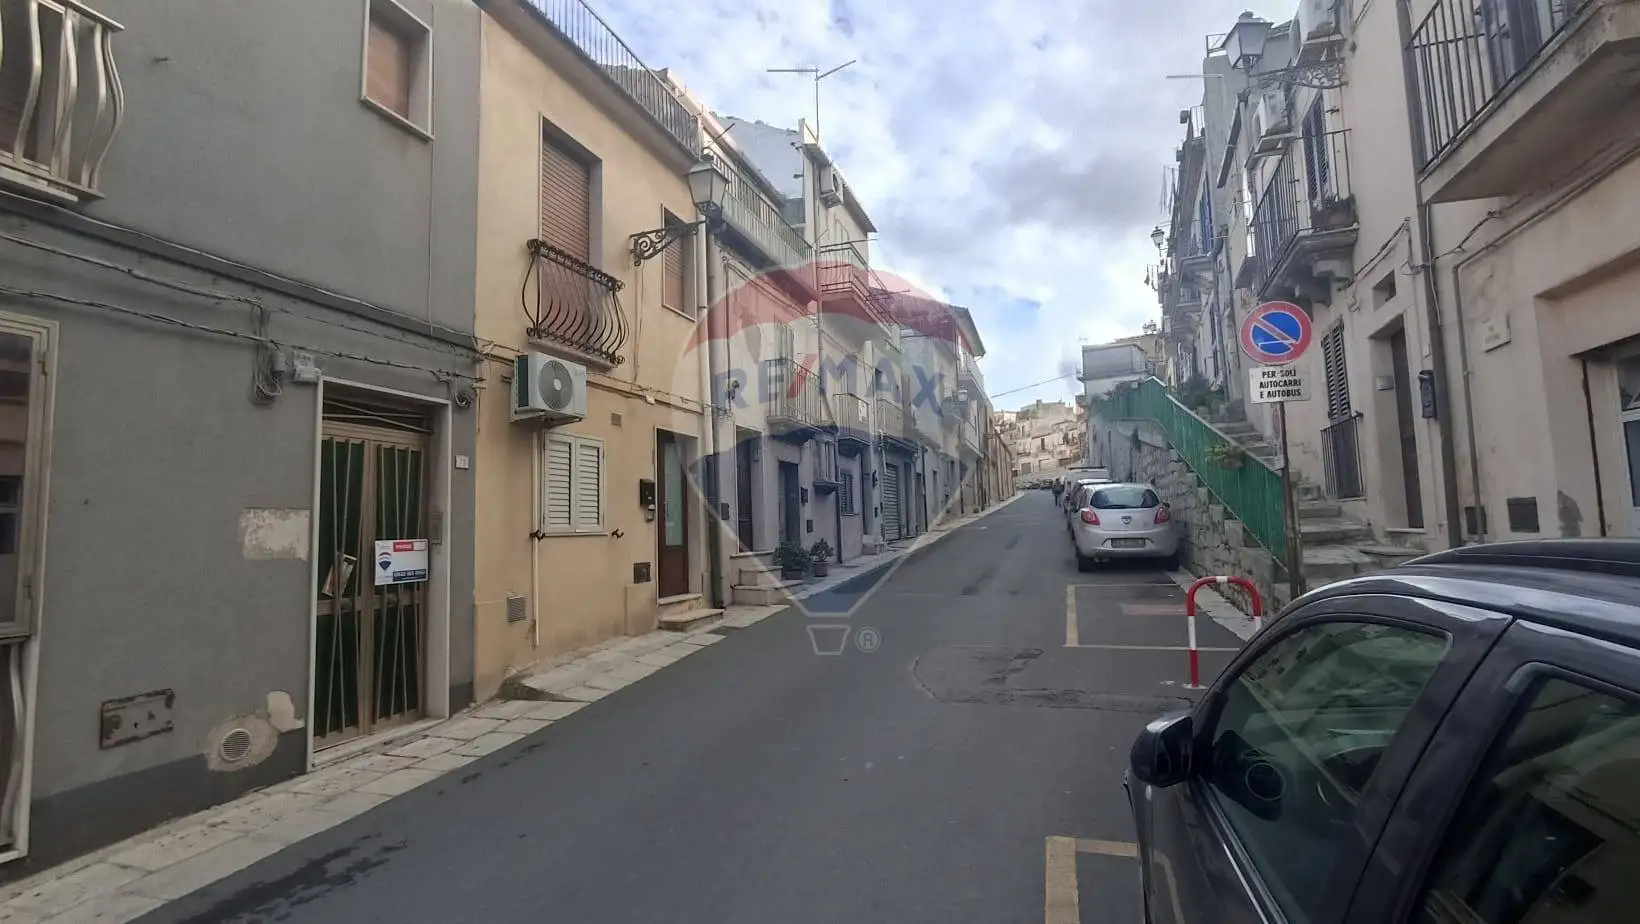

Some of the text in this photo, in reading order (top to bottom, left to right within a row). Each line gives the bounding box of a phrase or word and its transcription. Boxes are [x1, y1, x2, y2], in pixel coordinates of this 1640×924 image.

[1262, 369, 1297, 378] PER SOLI
[1259, 379, 1302, 389] AUTOCARRI
[1260, 389, 1302, 399] E AUTOBUS
